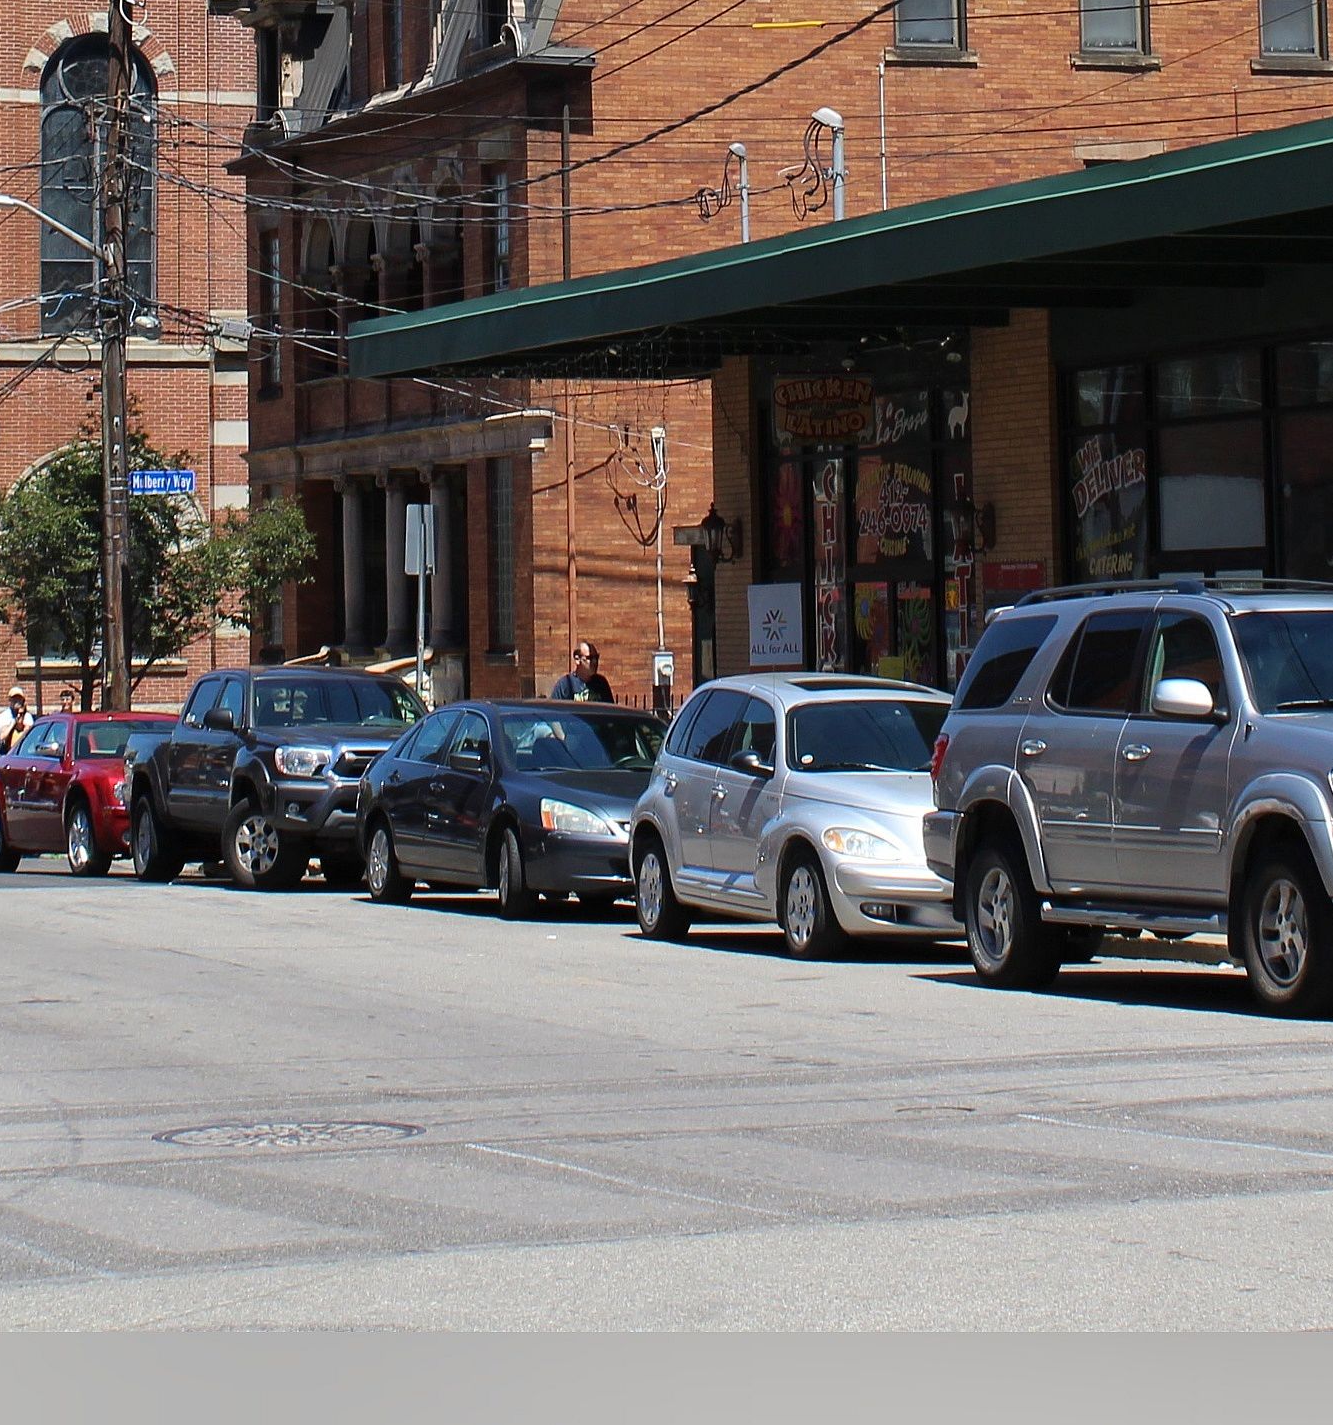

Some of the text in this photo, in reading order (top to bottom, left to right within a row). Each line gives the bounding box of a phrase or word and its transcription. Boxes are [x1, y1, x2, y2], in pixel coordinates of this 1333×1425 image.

[773, 376, 875, 407] CHICKEN
[784, 412, 867, 437] LATINO
[1075, 435, 1102, 476] WE
[132, 474, 192, 491] Mulberry Way
[1072, 447, 1147, 519] DELIVER
[858, 503, 929, 536] 246-0974
[1089, 551, 1134, 576] CATERING
[751, 642, 801, 655] ALL for ALL
